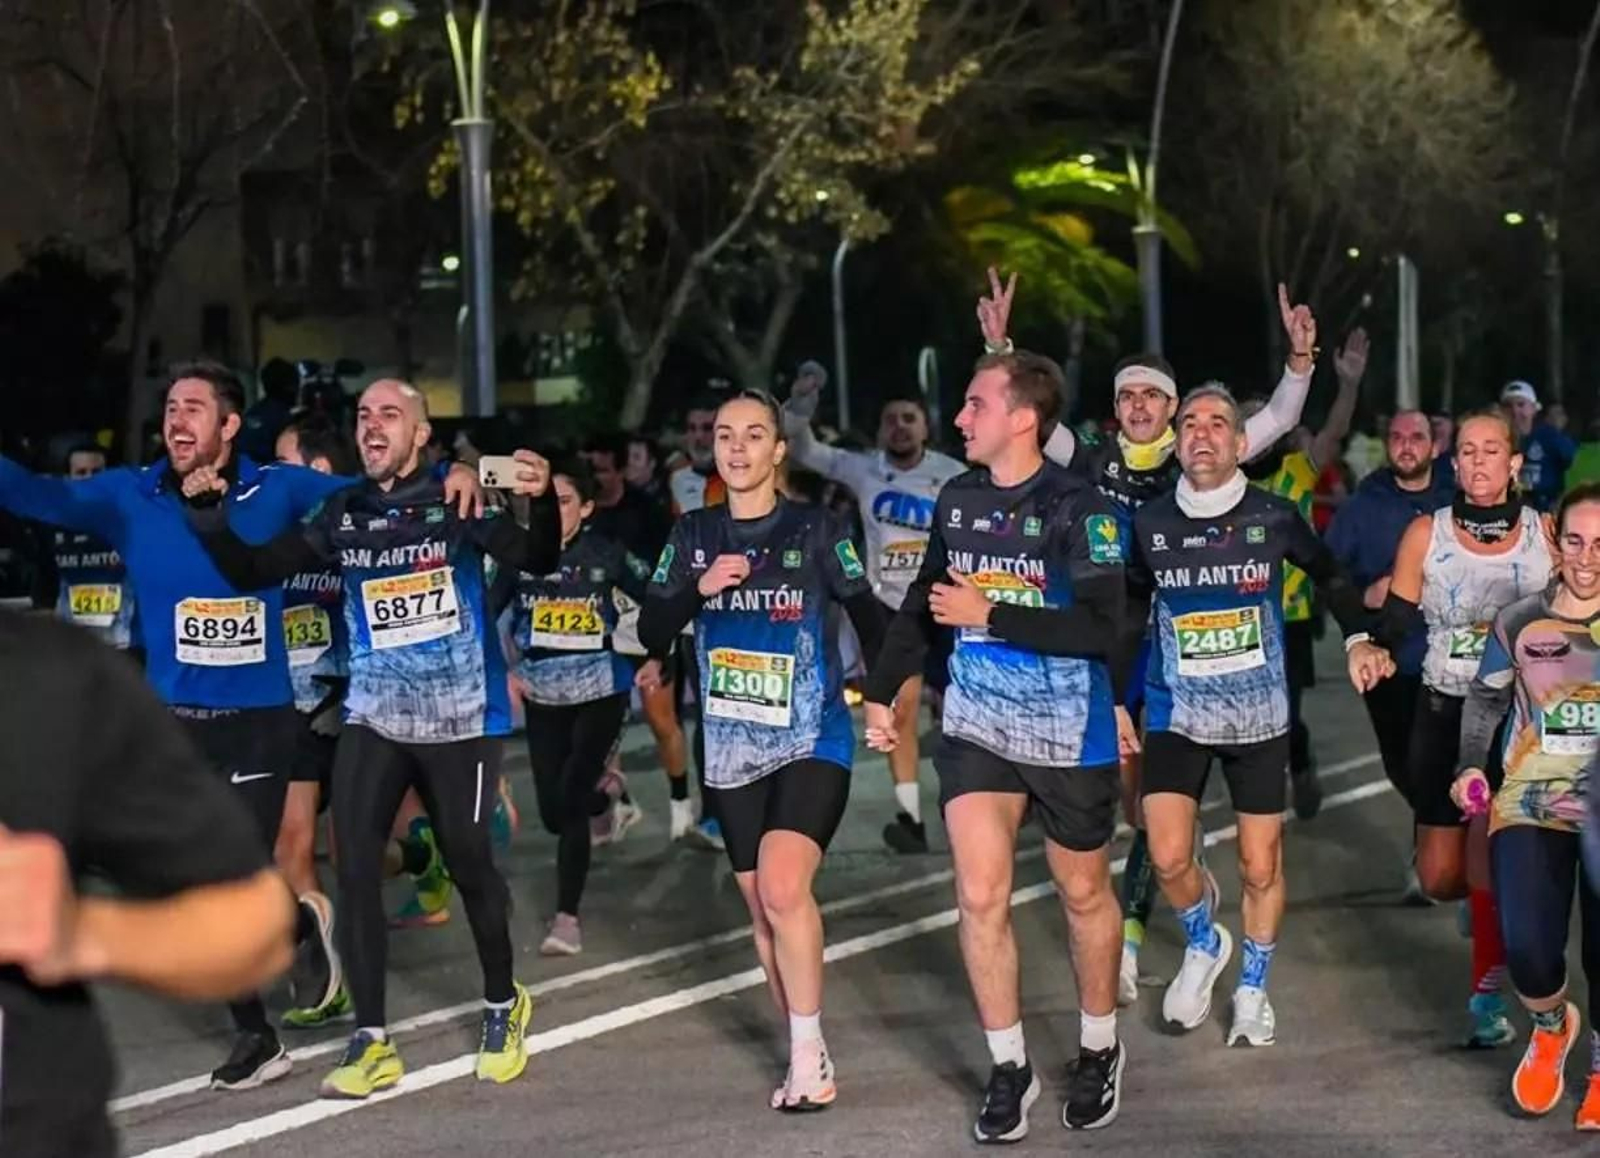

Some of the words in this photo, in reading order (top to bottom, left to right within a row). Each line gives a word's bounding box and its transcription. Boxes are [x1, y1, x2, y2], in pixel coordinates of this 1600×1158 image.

[82, 550, 120, 568] ANTÓ
[376, 537, 447, 568] ANTÓN
[947, 549, 974, 574] SAN
[977, 553, 1045, 578] ANTÓN
[290, 570, 342, 592] ANTÓN
[1154, 569, 1191, 589] SAN
[1197, 558, 1270, 586] ANTÓN
[374, 587, 445, 622] 6877
[730, 584, 804, 611] ANTÓN
[183, 615, 258, 640] 6894
[286, 620, 324, 643] 133
[1182, 623, 1254, 655] 2487
[716, 666, 784, 700] 1300
[1560, 702, 1600, 728] 98
